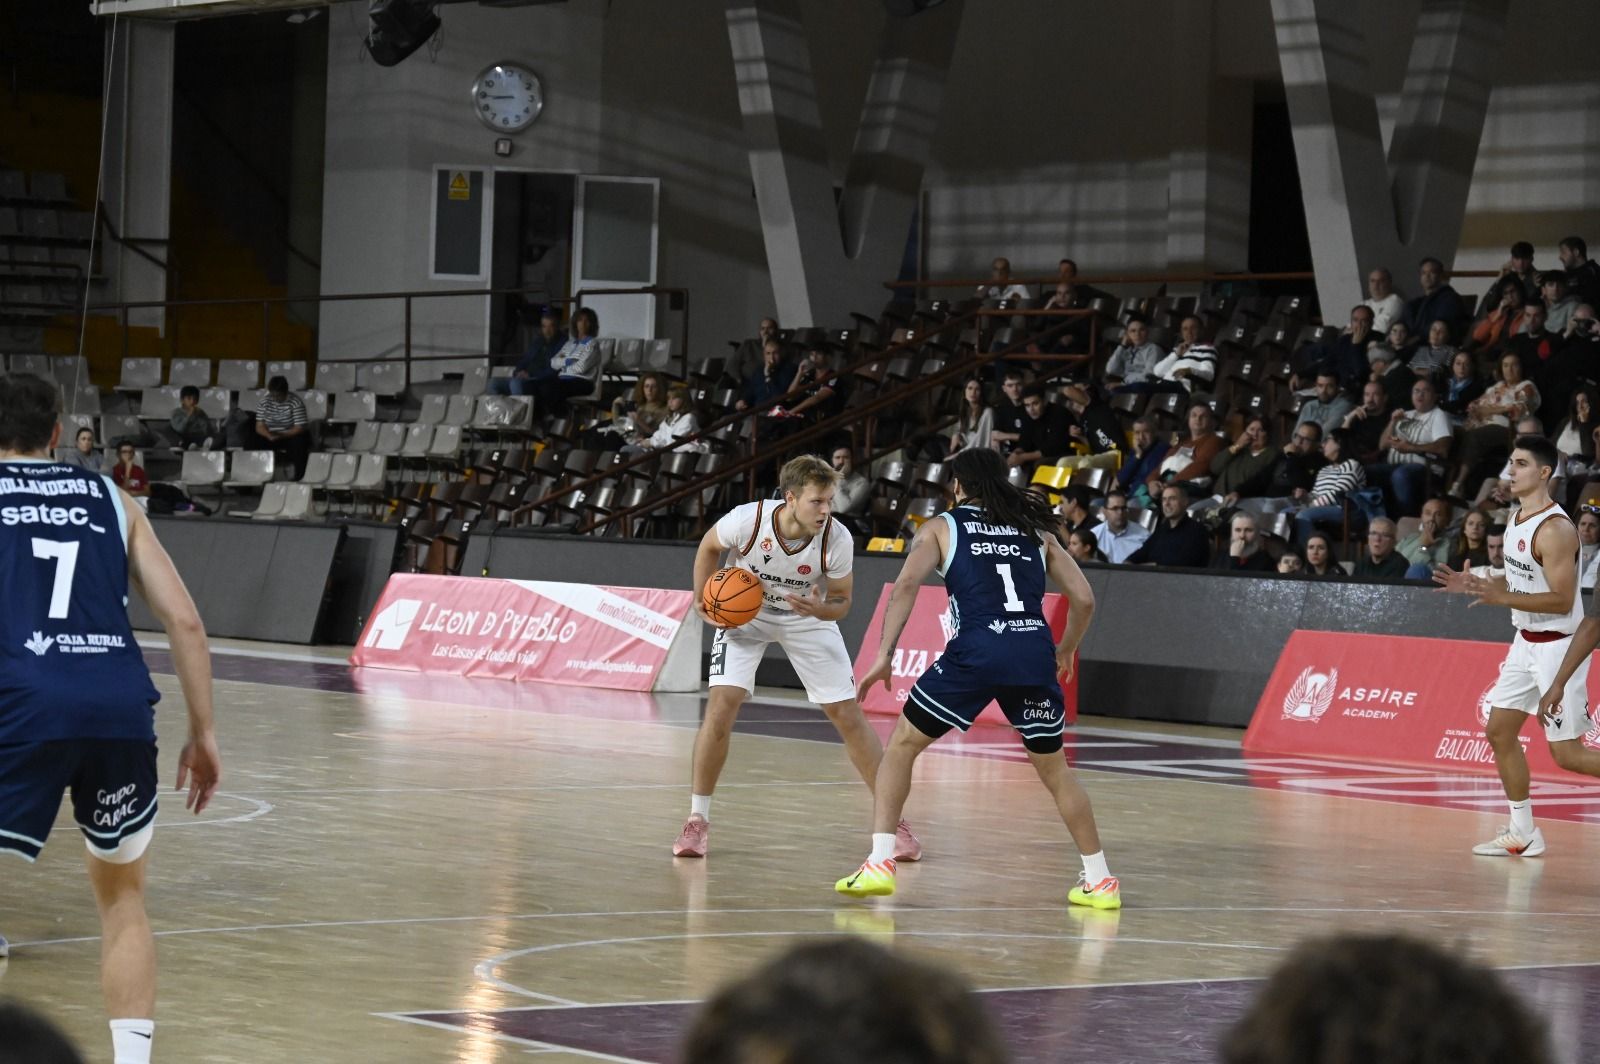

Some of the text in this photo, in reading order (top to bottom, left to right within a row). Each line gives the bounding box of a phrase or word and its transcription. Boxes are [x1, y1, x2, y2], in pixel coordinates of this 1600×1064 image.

[0, 477, 88, 496] OLLANDERS
[31, 537, 80, 619] 7
[995, 563, 1025, 612] 1
[86, 633, 126, 647] RURAL
[891, 648, 928, 678] AJA
[1338, 687, 1418, 708] ASPIRE
[1342, 708, 1398, 720] ACADEMY
[1435, 737, 1496, 764] BALONCE
[97, 783, 136, 806] Grupo
